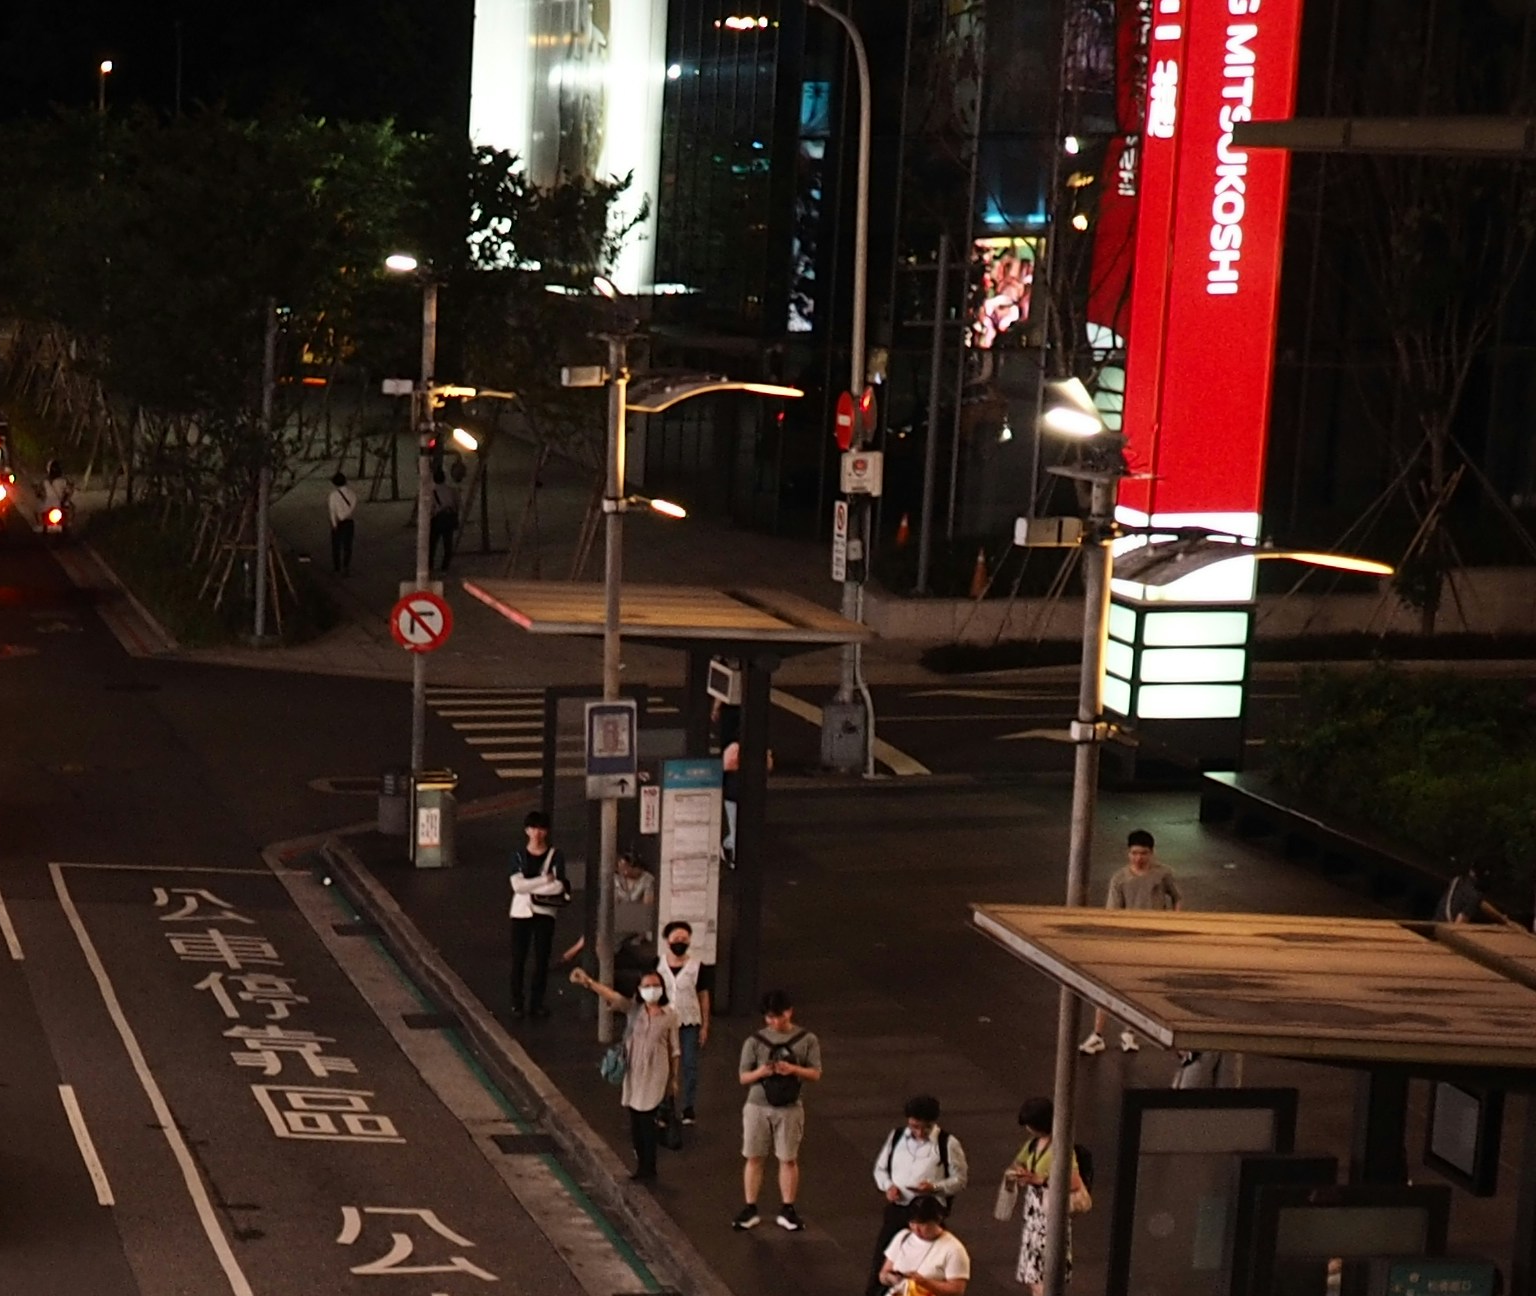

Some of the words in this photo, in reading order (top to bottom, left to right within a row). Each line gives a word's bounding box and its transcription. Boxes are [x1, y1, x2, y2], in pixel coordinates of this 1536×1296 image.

[150, 884, 407, 1144] 公車停靠區
